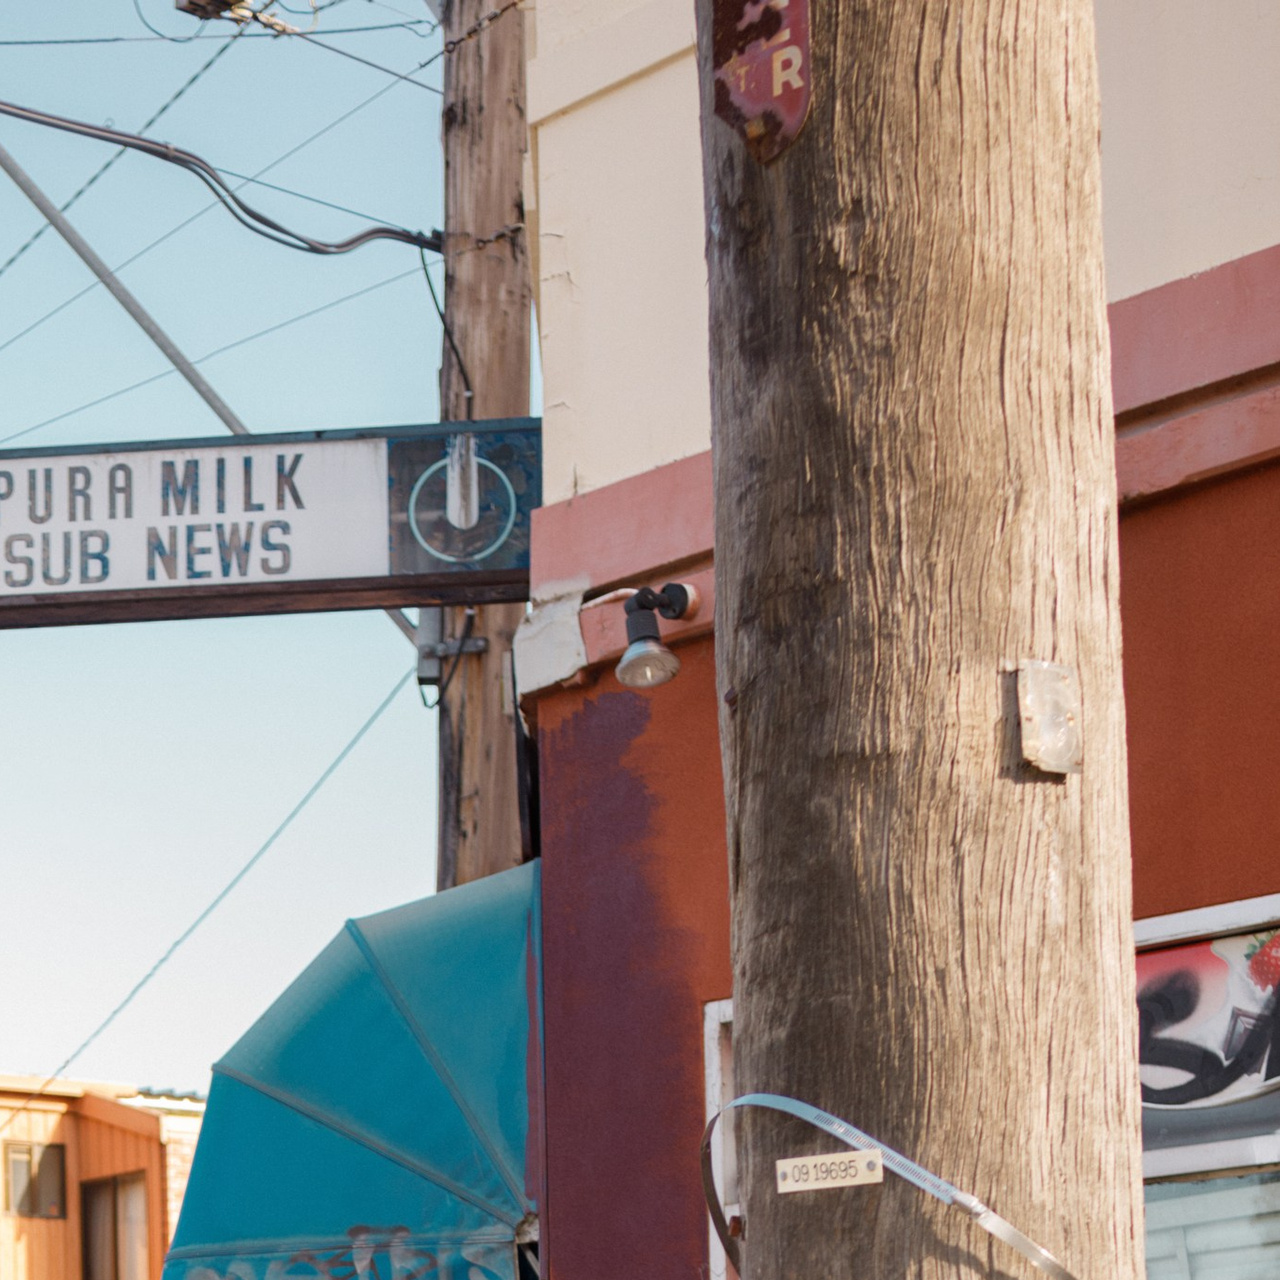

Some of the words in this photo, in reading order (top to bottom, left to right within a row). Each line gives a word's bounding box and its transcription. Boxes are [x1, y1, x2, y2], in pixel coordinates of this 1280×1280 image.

[161, 453, 306, 517] MILK
[4, 529, 110, 588] SUB
[146, 520, 292, 581] NEWS
